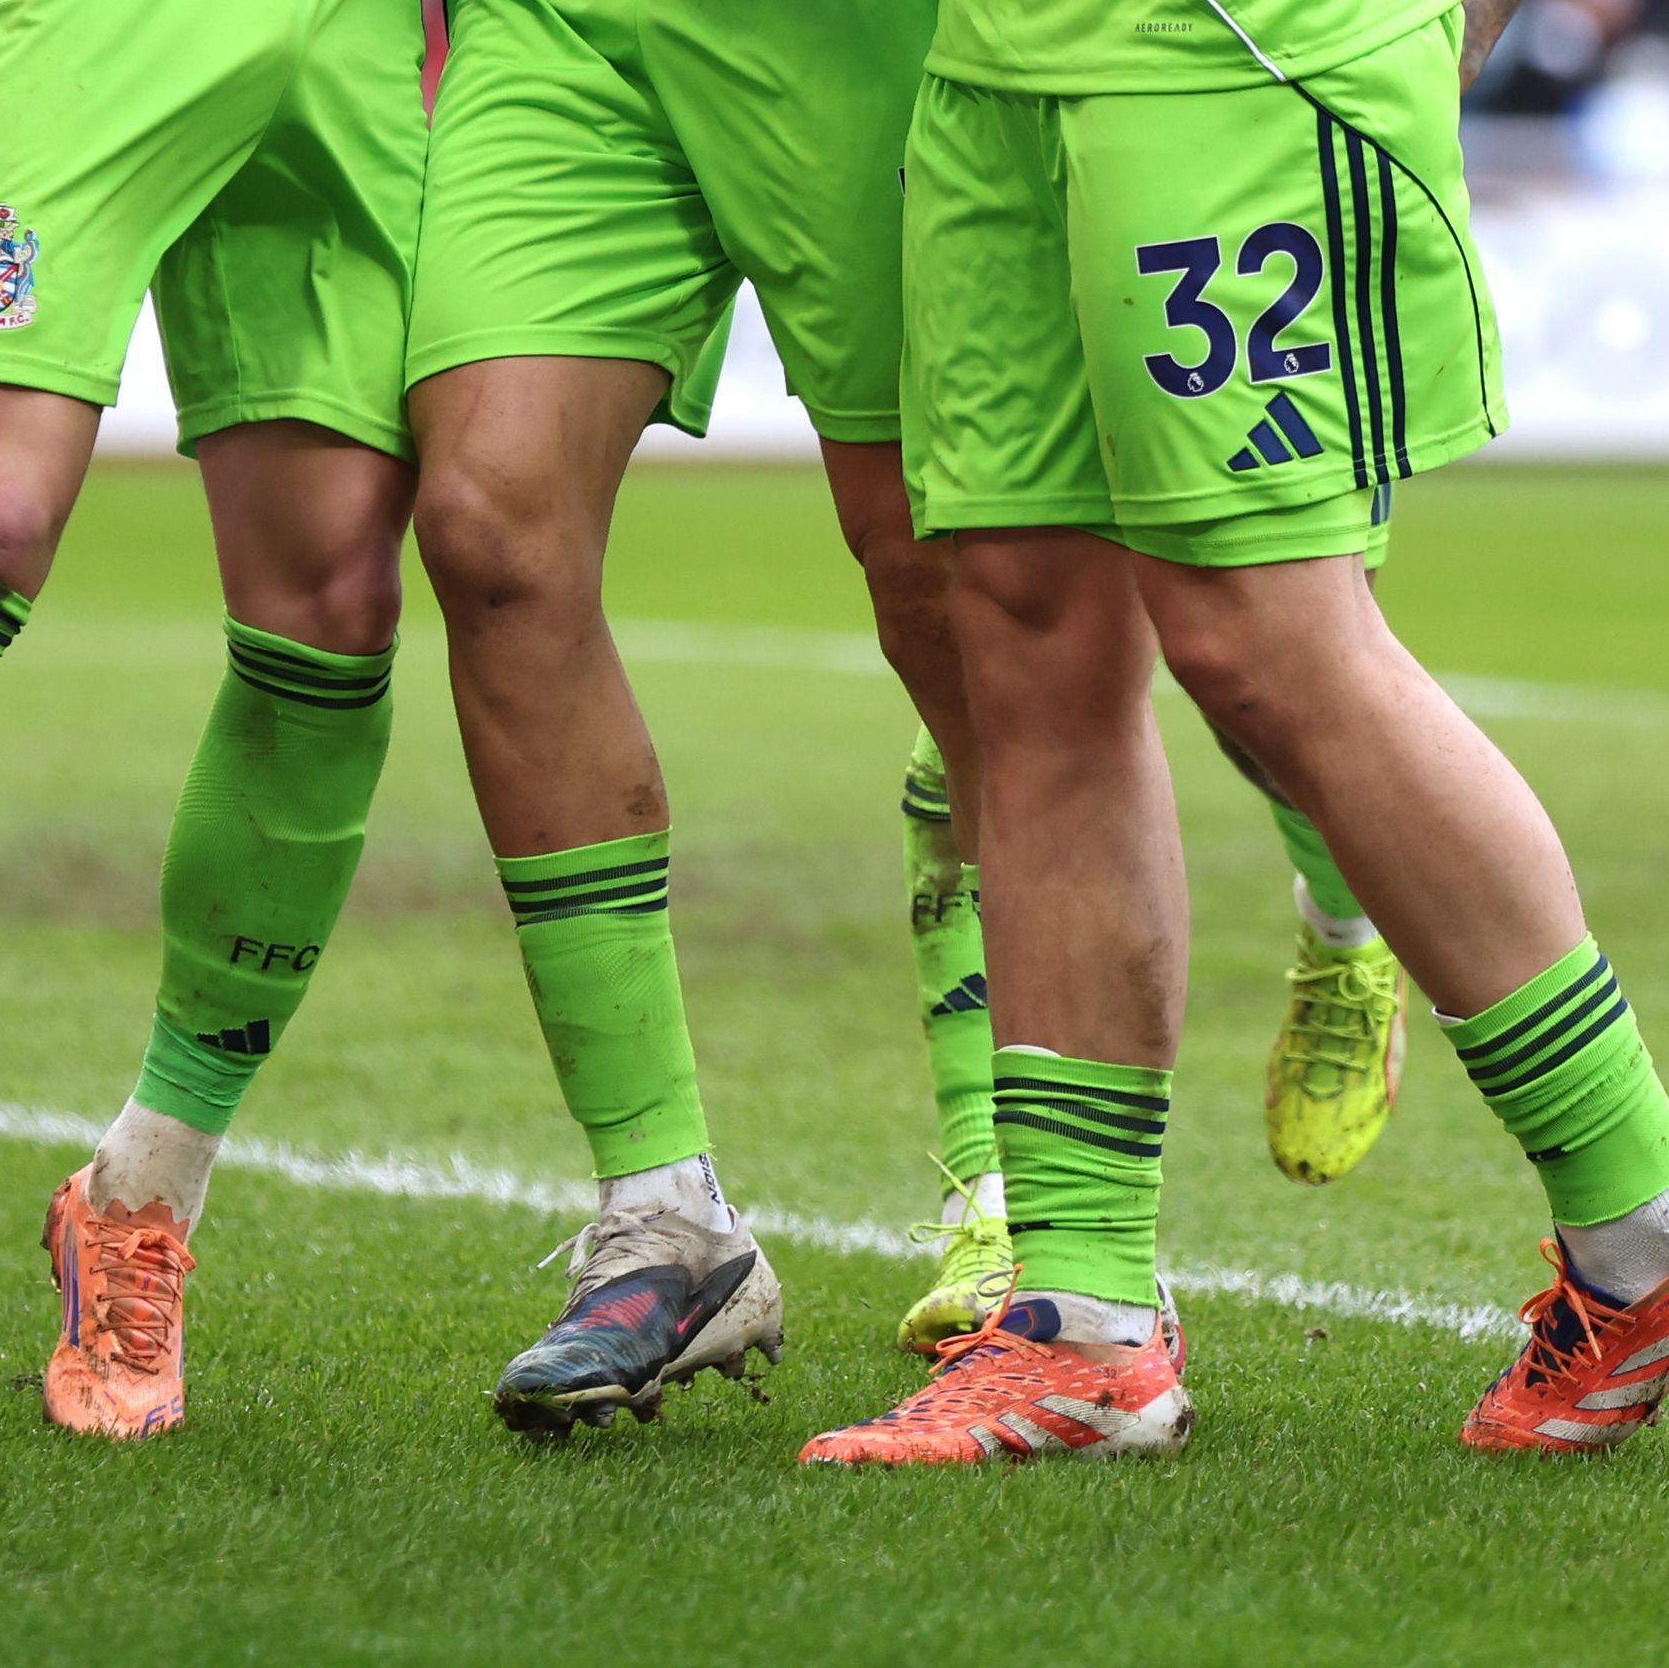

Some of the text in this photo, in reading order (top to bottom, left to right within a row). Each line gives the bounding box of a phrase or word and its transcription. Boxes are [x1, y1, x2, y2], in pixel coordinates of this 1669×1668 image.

[1134, 22, 1193, 33] AEROREADY
[1135, 221, 1332, 400] 32
[912, 891, 970, 925] FF
[230, 935, 320, 971] FFC
